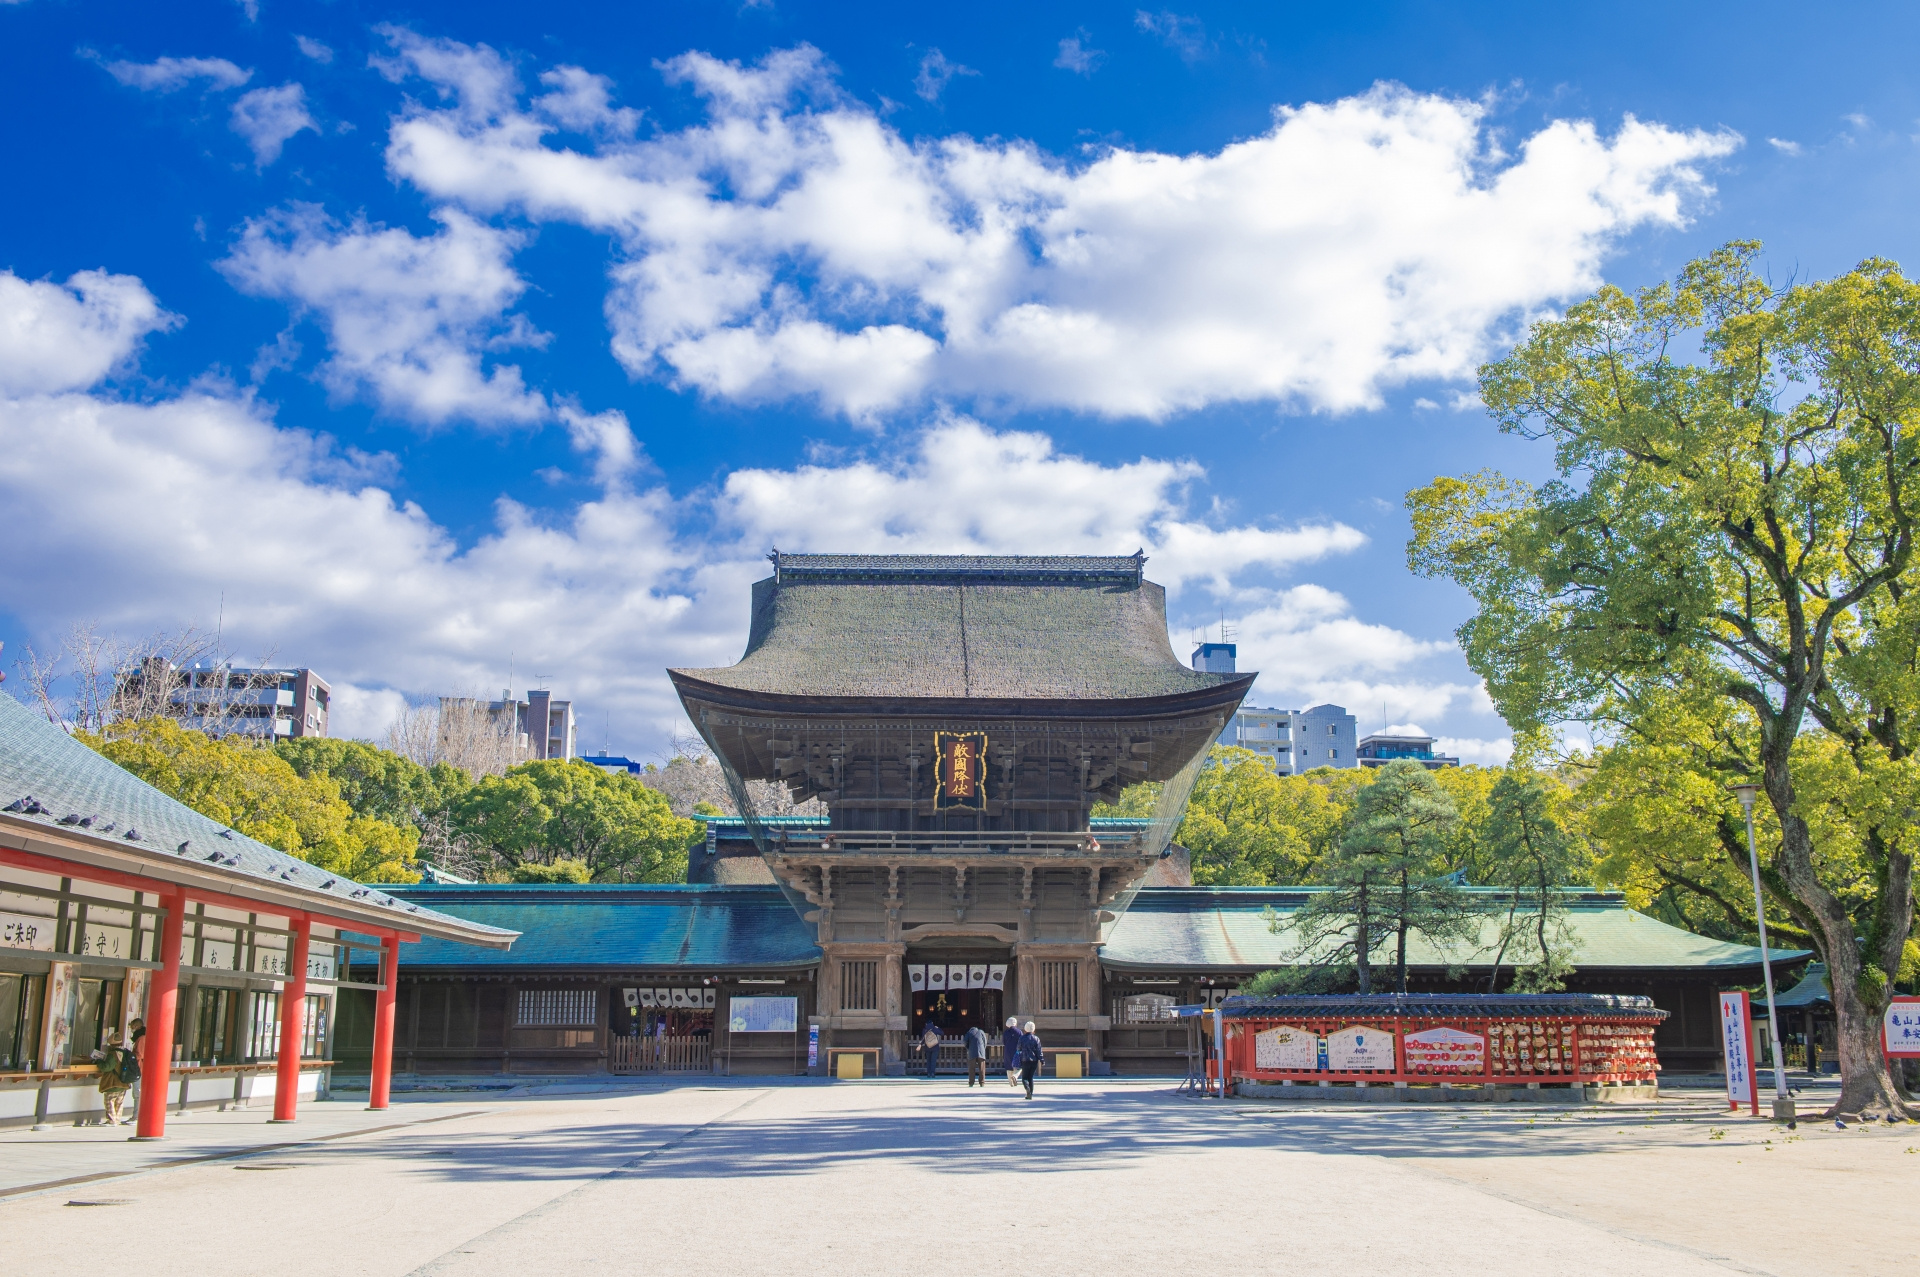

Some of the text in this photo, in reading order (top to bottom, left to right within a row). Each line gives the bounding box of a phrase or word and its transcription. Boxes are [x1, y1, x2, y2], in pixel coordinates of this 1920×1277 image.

[4, 923, 37, 945] ご朱印
[83, 932, 119, 954] お守り
